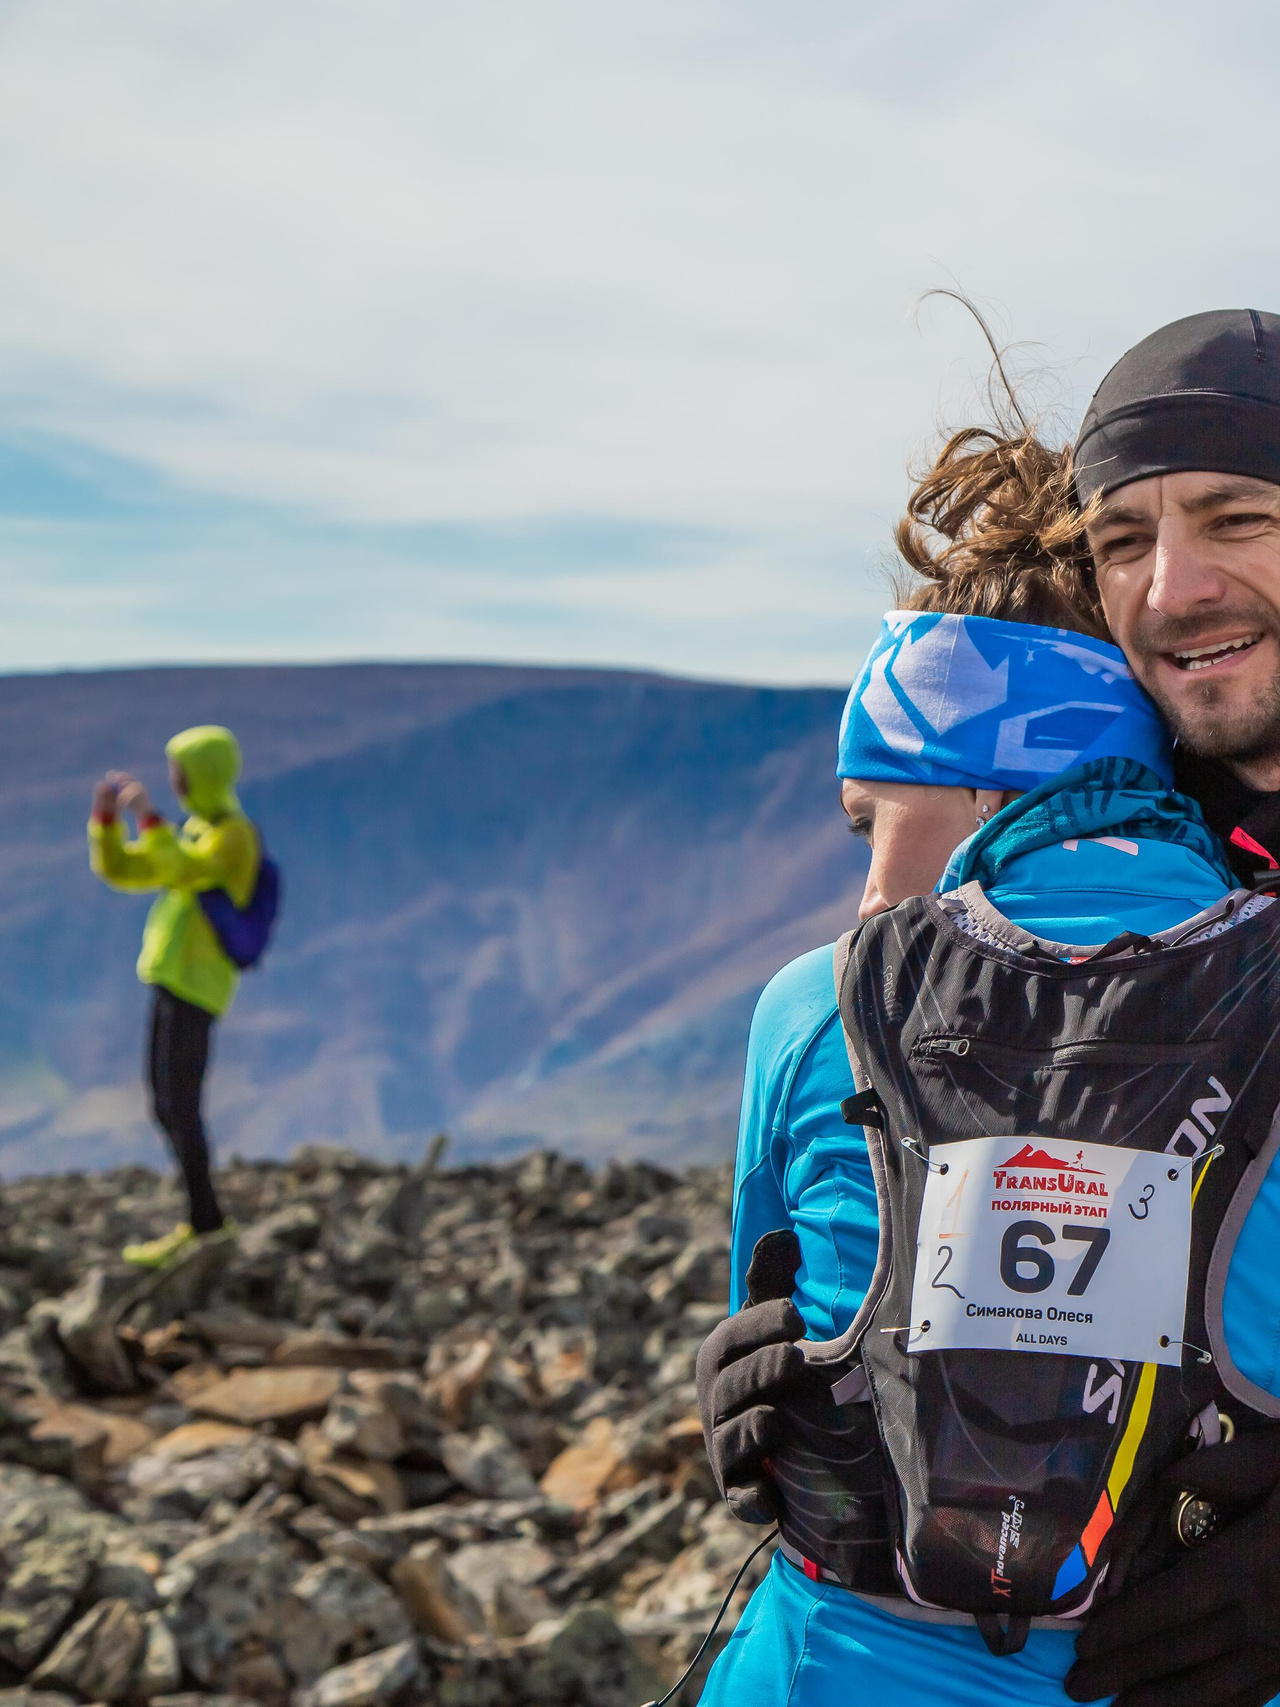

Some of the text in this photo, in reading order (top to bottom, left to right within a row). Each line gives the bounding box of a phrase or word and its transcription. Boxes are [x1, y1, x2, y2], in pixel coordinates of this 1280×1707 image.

[991, 1200, 1108, 1218] ПОЛЯРНЫЙ ЭТАП
[1128, 1184, 1155, 1220] 3
[931, 1245, 966, 1299] 2
[999, 1219, 1111, 1297] 67
[965, 1303, 1093, 1324] Симакова Олеся
[1016, 1333, 1068, 1346] ALL DAYS
